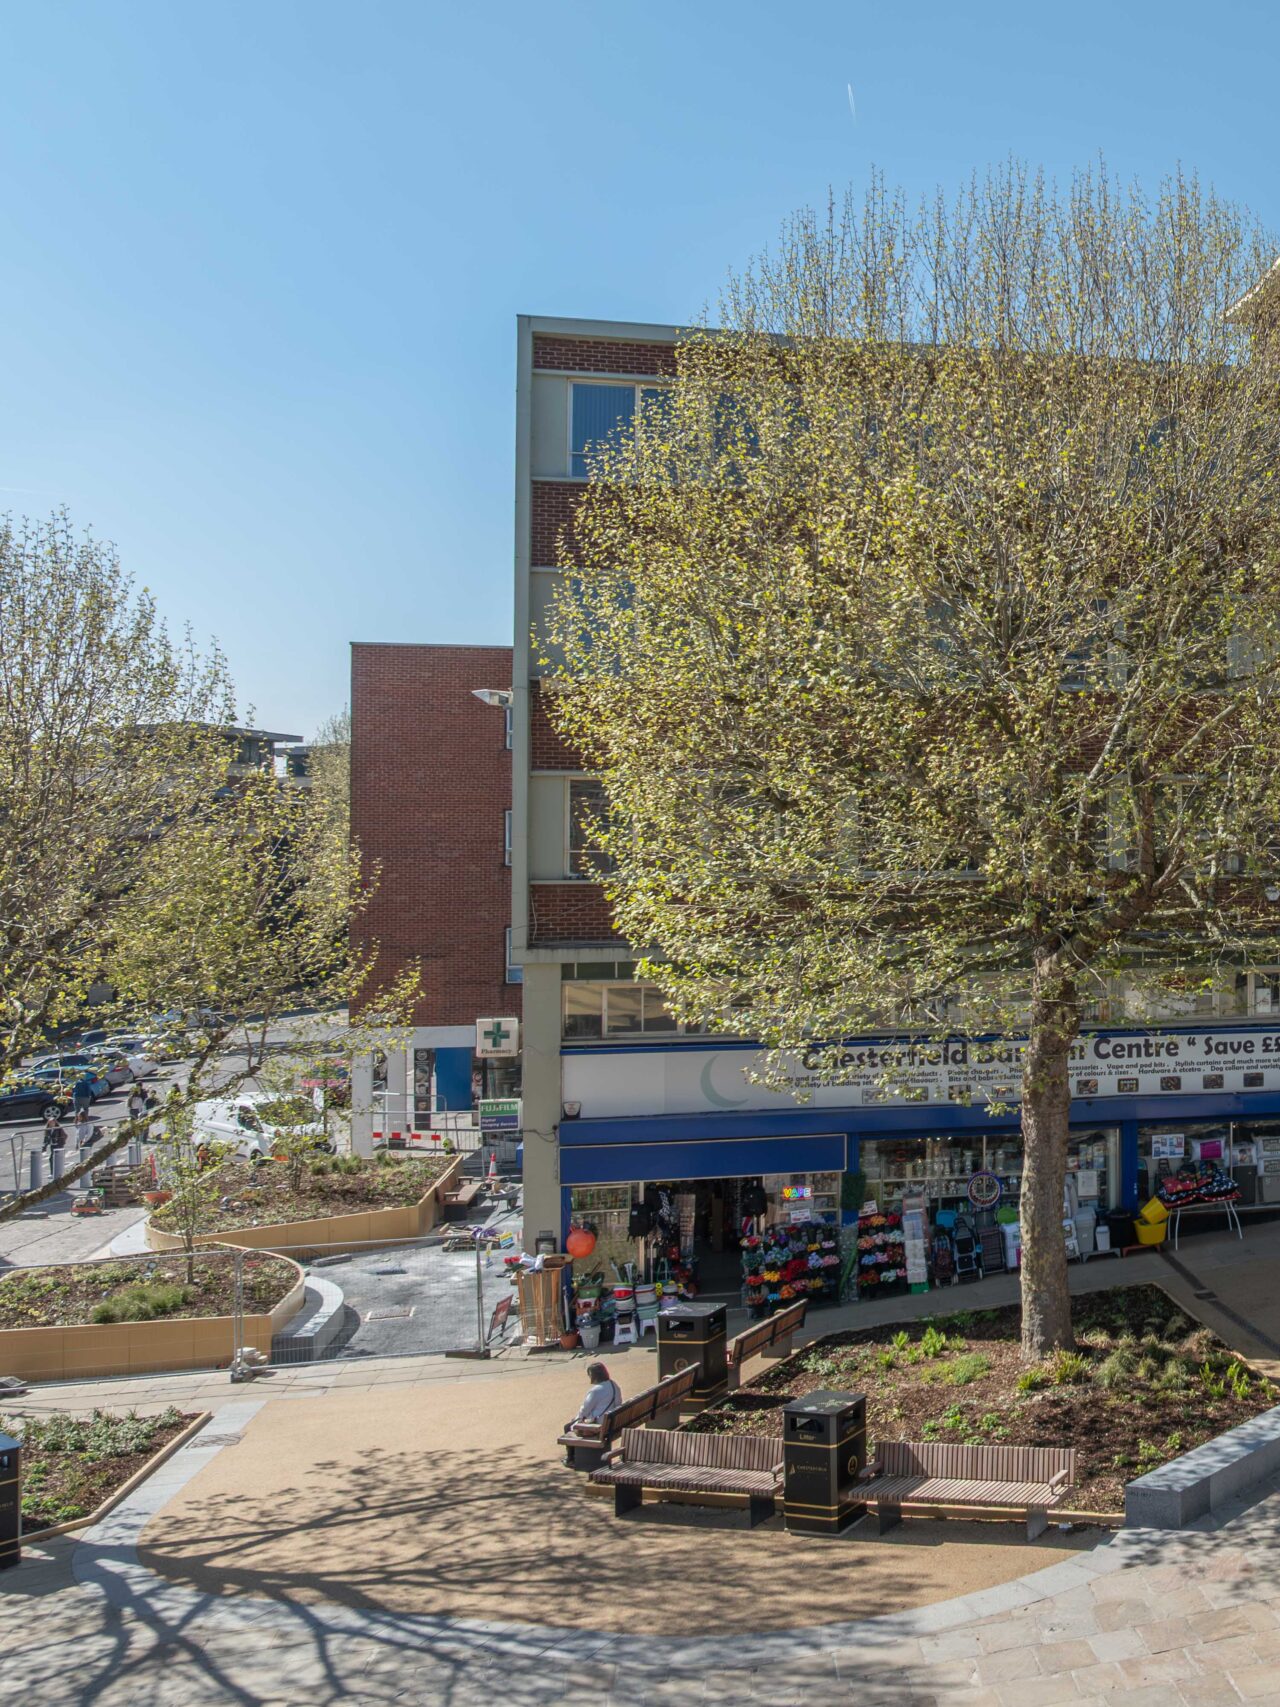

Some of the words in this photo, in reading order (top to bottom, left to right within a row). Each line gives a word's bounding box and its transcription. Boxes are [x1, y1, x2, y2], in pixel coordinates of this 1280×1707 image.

[801, 1043, 968, 1070] Cesterfield
[1094, 1038, 1179, 1059] Centre
[1204, 1036, 1255, 1056] Save
[1175, 1060, 1195, 1068] Stylish
[783, 1187, 812, 1198] VAPE
